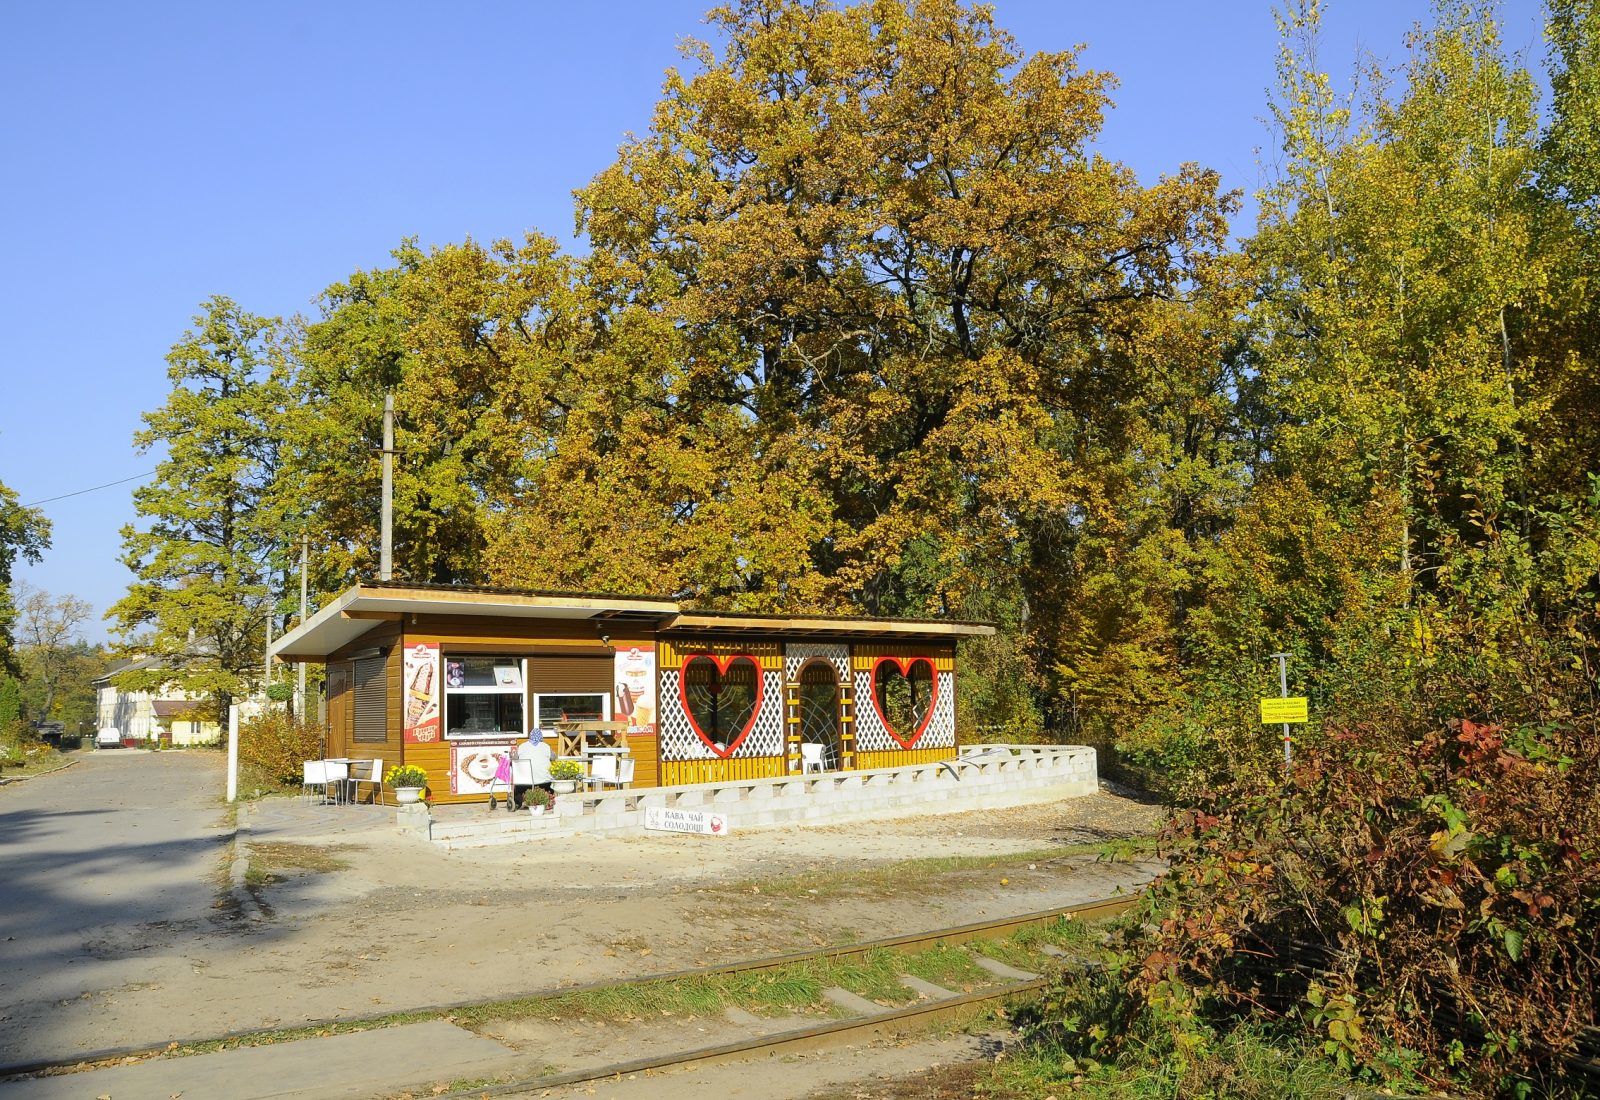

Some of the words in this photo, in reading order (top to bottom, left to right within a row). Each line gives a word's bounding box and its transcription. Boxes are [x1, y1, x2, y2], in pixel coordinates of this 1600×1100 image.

[664, 811, 685, 821] КАВА
[688, 812, 704, 822] ЧАЙ
[664, 821, 704, 832] СОЛОДОЩІ
